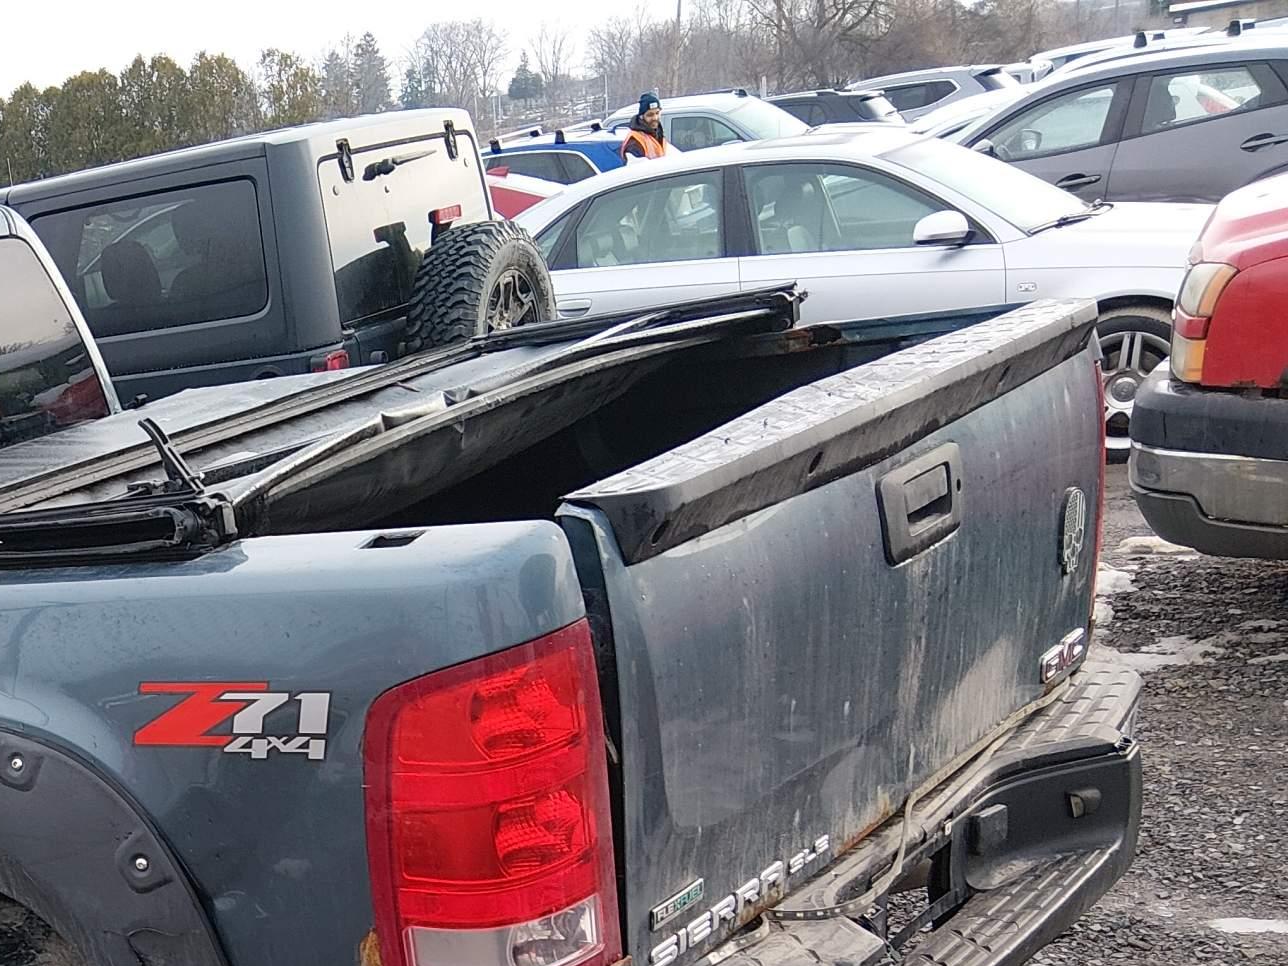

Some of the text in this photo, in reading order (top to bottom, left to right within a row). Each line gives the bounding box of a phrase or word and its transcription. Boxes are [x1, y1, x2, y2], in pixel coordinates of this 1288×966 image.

[1039, 627, 1085, 684] GMC
[133, 681, 331, 747] Z71
[789, 834, 830, 875] SLE
